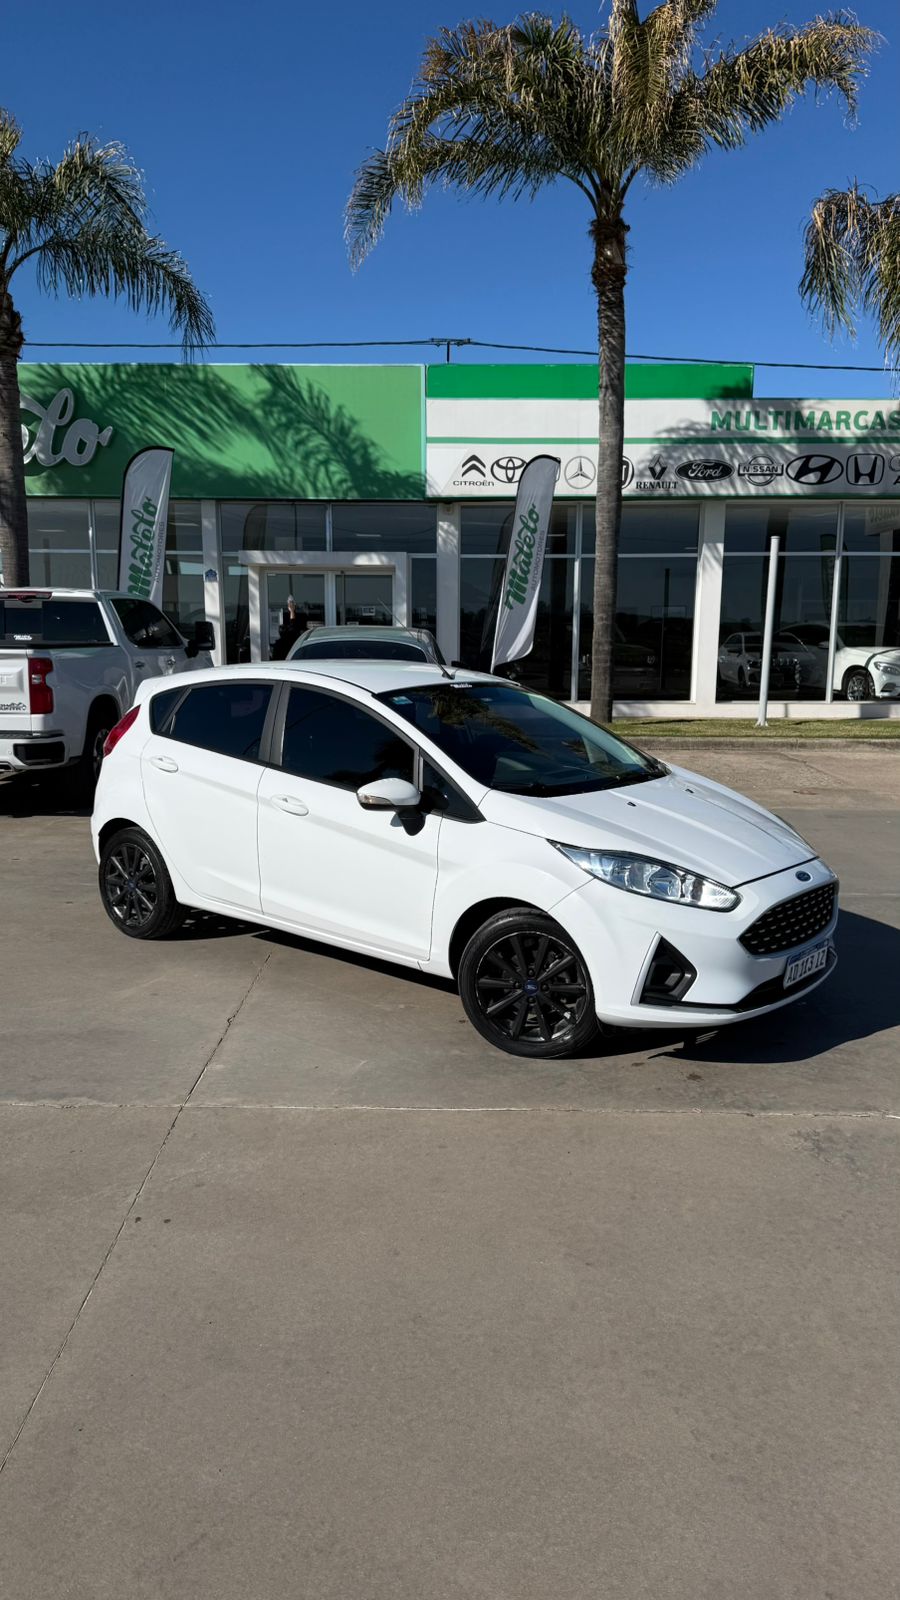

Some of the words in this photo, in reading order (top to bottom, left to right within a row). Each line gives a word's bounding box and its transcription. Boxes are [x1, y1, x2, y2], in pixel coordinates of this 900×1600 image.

[711, 410, 900, 431] MULTIMARCAS
[687, 462, 722, 478] Ford
[742, 465, 779, 473] NSSAN
[635, 481, 678, 490] RENAULT
